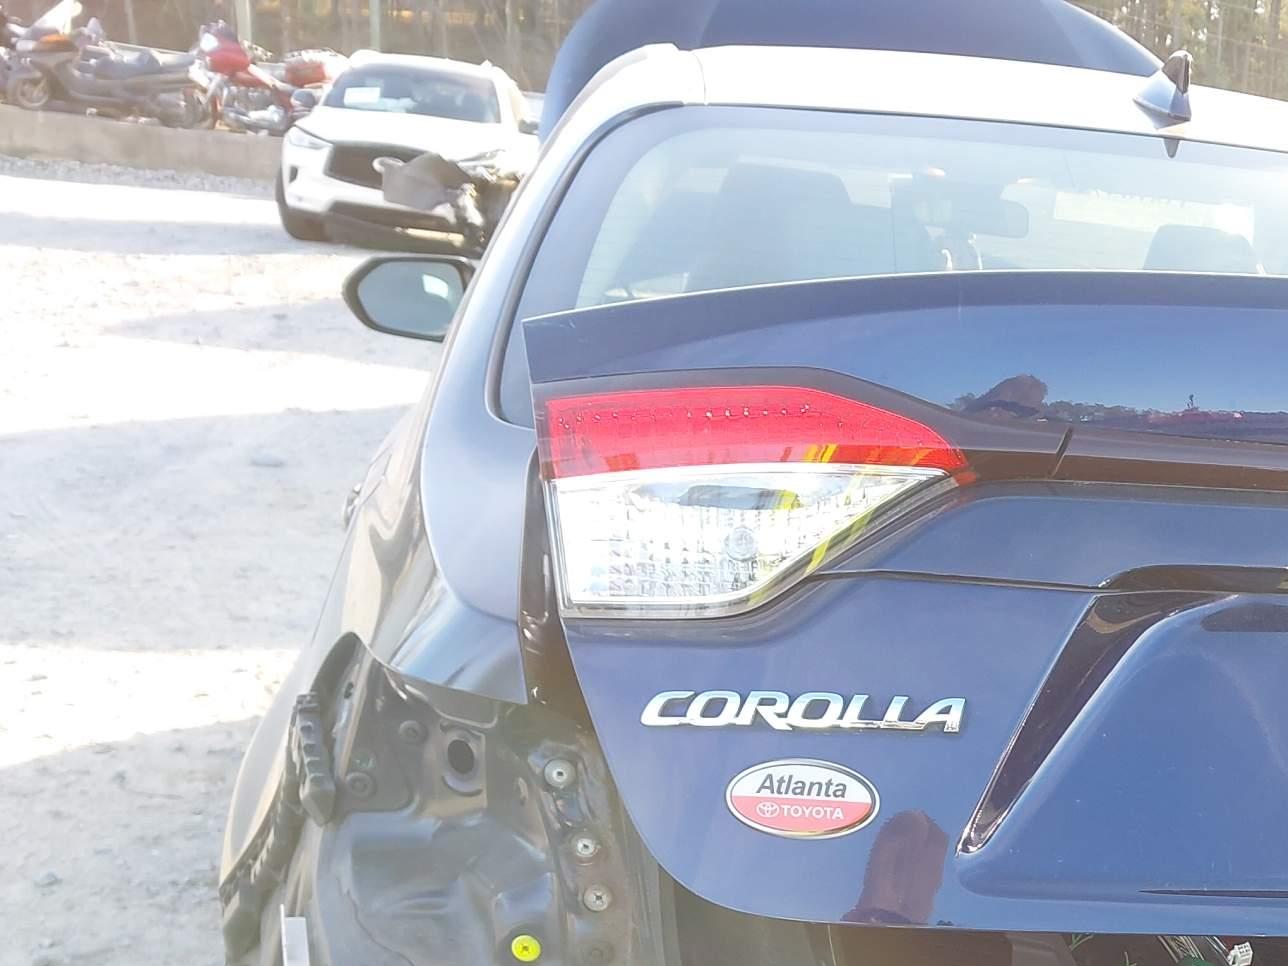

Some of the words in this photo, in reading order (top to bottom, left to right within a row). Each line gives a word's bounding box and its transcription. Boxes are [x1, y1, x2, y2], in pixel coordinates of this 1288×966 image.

[640, 690, 966, 733] COROLLA
[756, 773, 847, 799] Atlanta
[781, 803, 844, 820] TOYOTA
